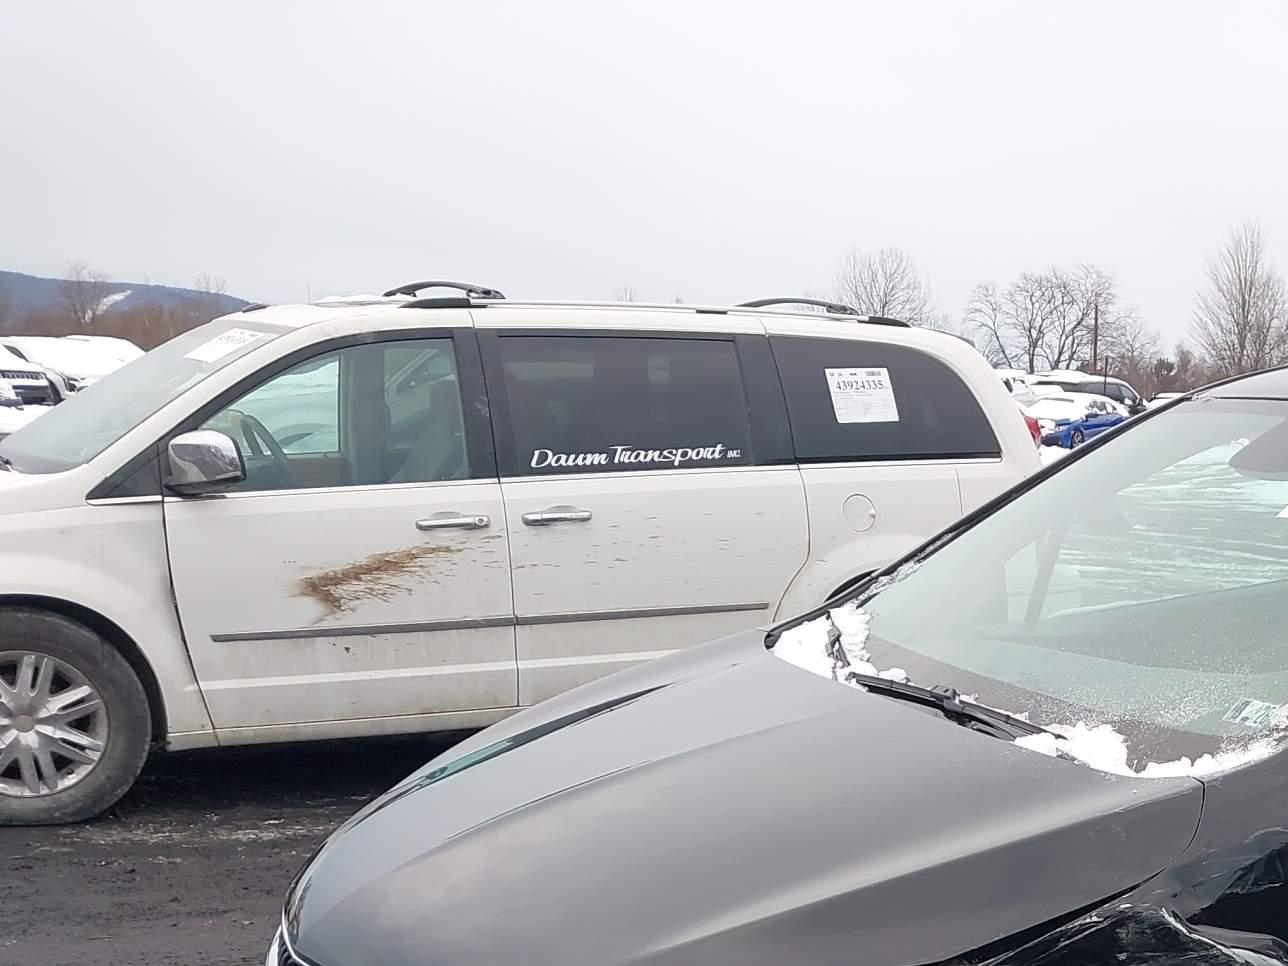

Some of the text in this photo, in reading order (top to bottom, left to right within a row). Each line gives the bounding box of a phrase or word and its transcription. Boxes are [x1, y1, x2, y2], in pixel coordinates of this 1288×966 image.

[836, 380, 884, 391] 43924335
[530, 449, 609, 468] Daum
[609, 444, 726, 466] Transport
